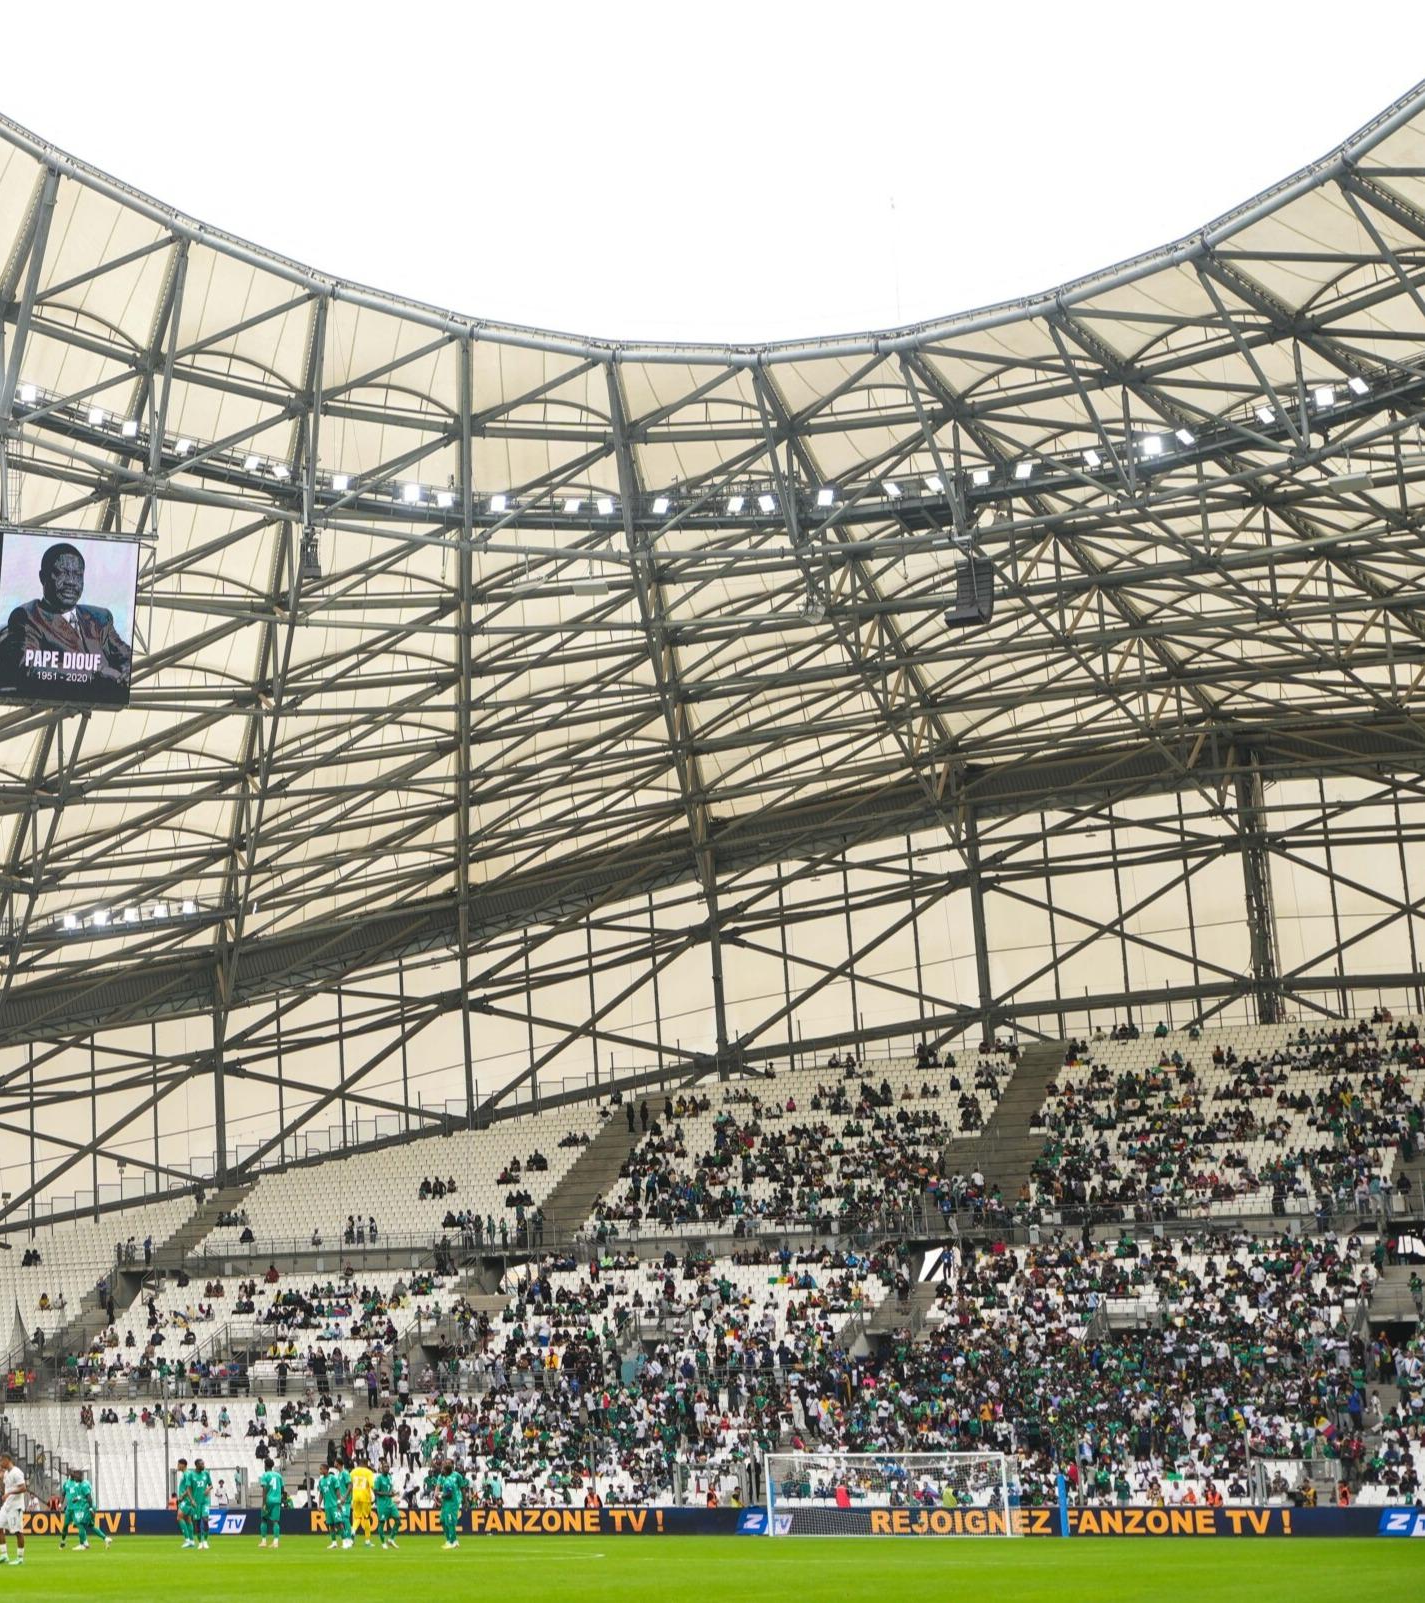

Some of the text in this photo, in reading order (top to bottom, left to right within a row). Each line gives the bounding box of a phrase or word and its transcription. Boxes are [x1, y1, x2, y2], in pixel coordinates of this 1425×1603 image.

[25, 649, 101, 671] PAPE DIOUF
[37, 671, 57, 680] 1951
[66, 672, 87, 682] 2020
[270, 1477, 277, 1490] 4
[471, 1511, 600, 1532] FANZONE
[609, 1511, 647, 1532] TV
[871, 1510, 1052, 1533] REJOIGNEZ
[1068, 1510, 1216, 1533] FANZONE
[1225, 1510, 1270, 1533] TV
